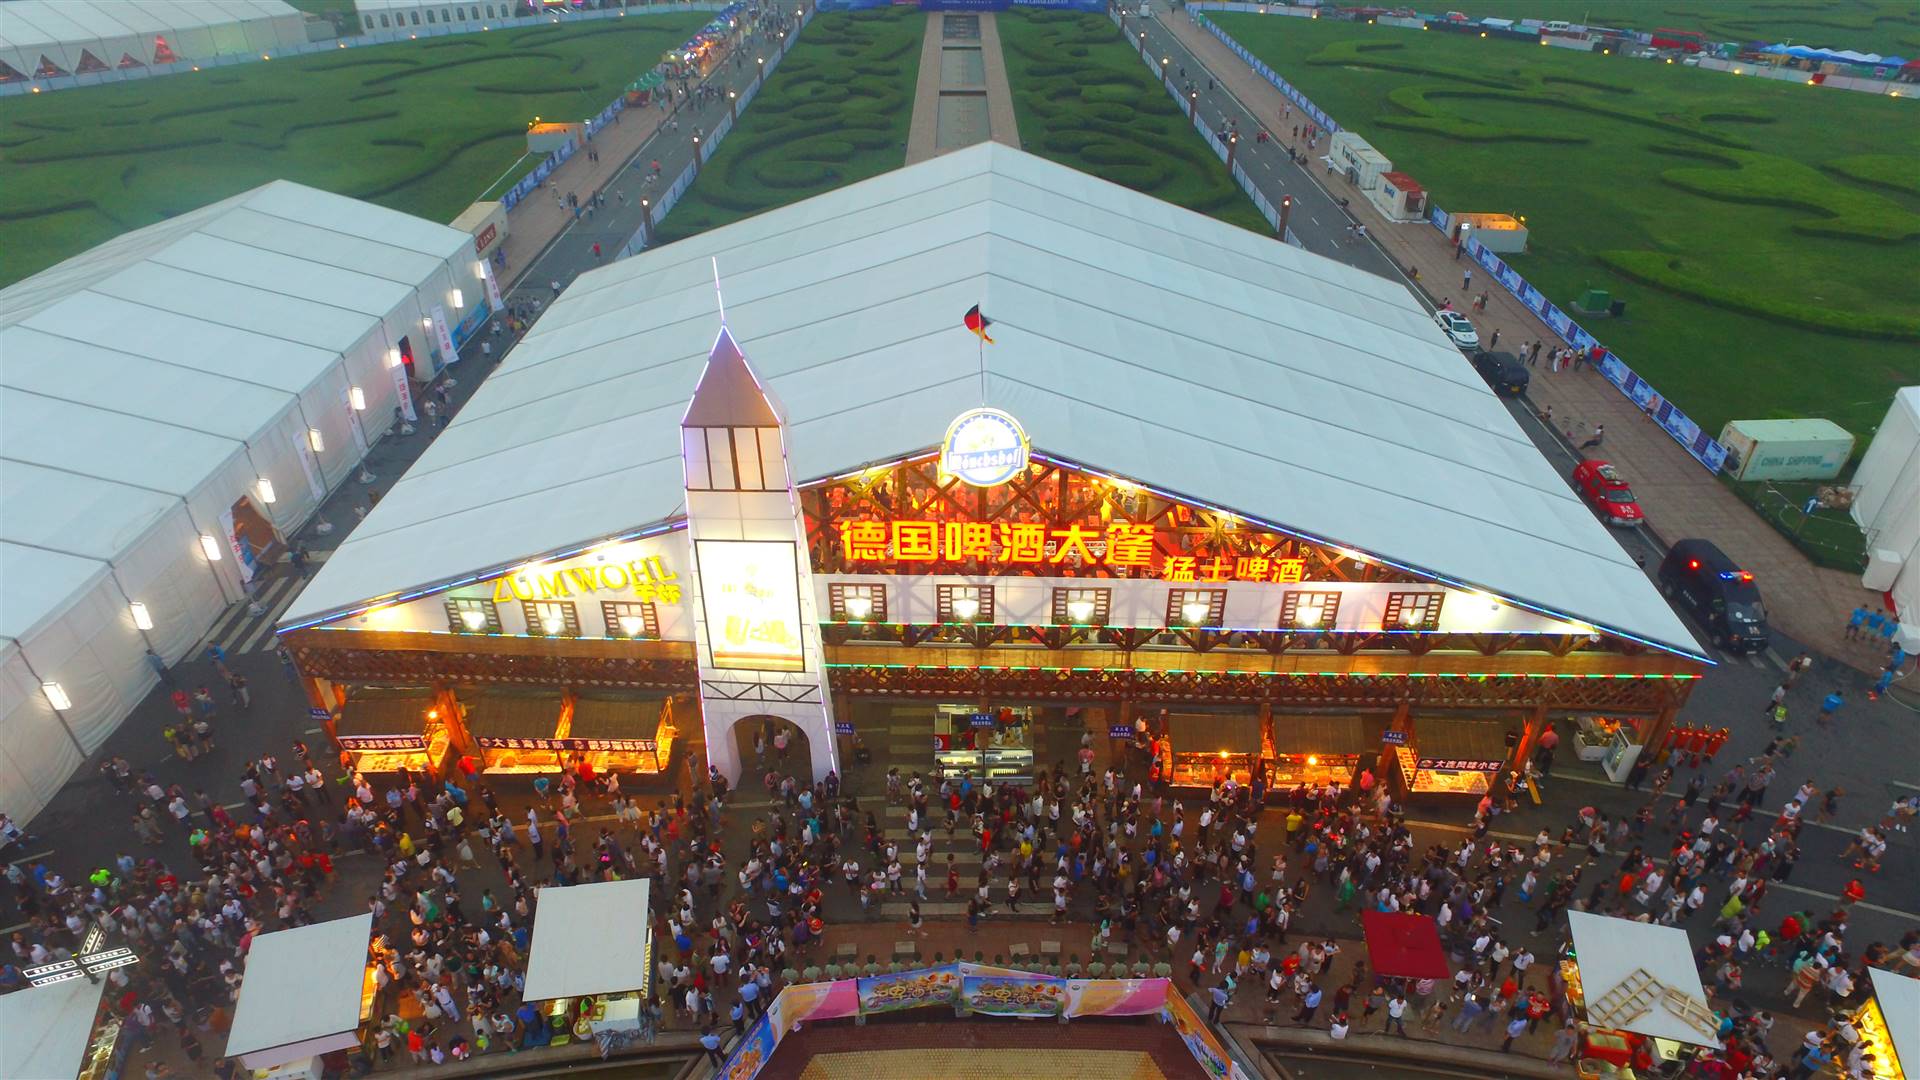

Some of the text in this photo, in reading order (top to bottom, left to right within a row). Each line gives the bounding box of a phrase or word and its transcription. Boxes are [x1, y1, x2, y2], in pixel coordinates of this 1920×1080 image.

[839, 519, 1156, 567] 德国啤酒大篷
[493, 555, 678, 603] ZUMWOHL
[1161, 554, 1307, 584] 猛士啤酒
[1434, 760, 1500, 770] 大连风味小吃
